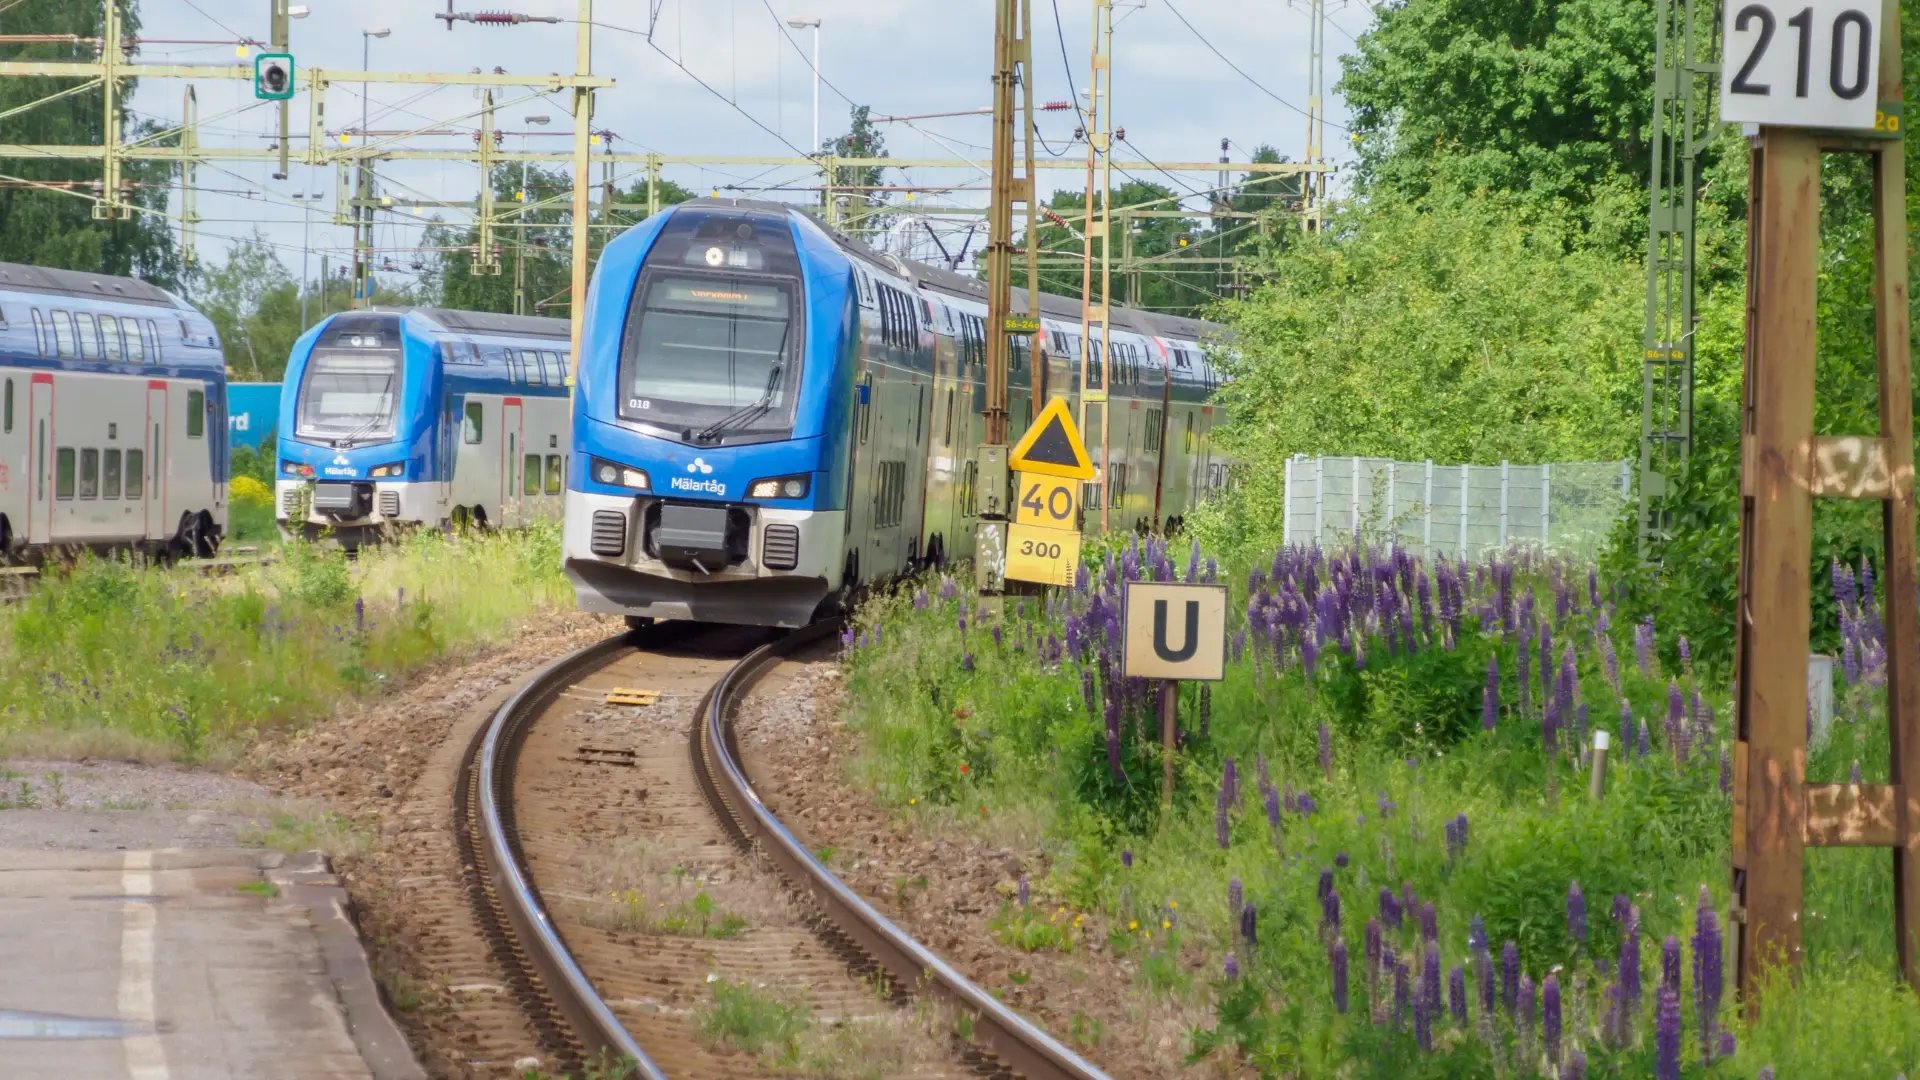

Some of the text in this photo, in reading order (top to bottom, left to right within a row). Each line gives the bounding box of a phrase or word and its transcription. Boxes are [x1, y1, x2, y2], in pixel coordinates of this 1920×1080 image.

[1730, 4, 1873, 100] 210
[629, 399, 651, 409] 018
[671, 477, 726, 496] Mälartåg
[1021, 483, 1073, 520] 40
[1020, 540, 1061, 560] 300
[1153, 599, 1200, 663] U
